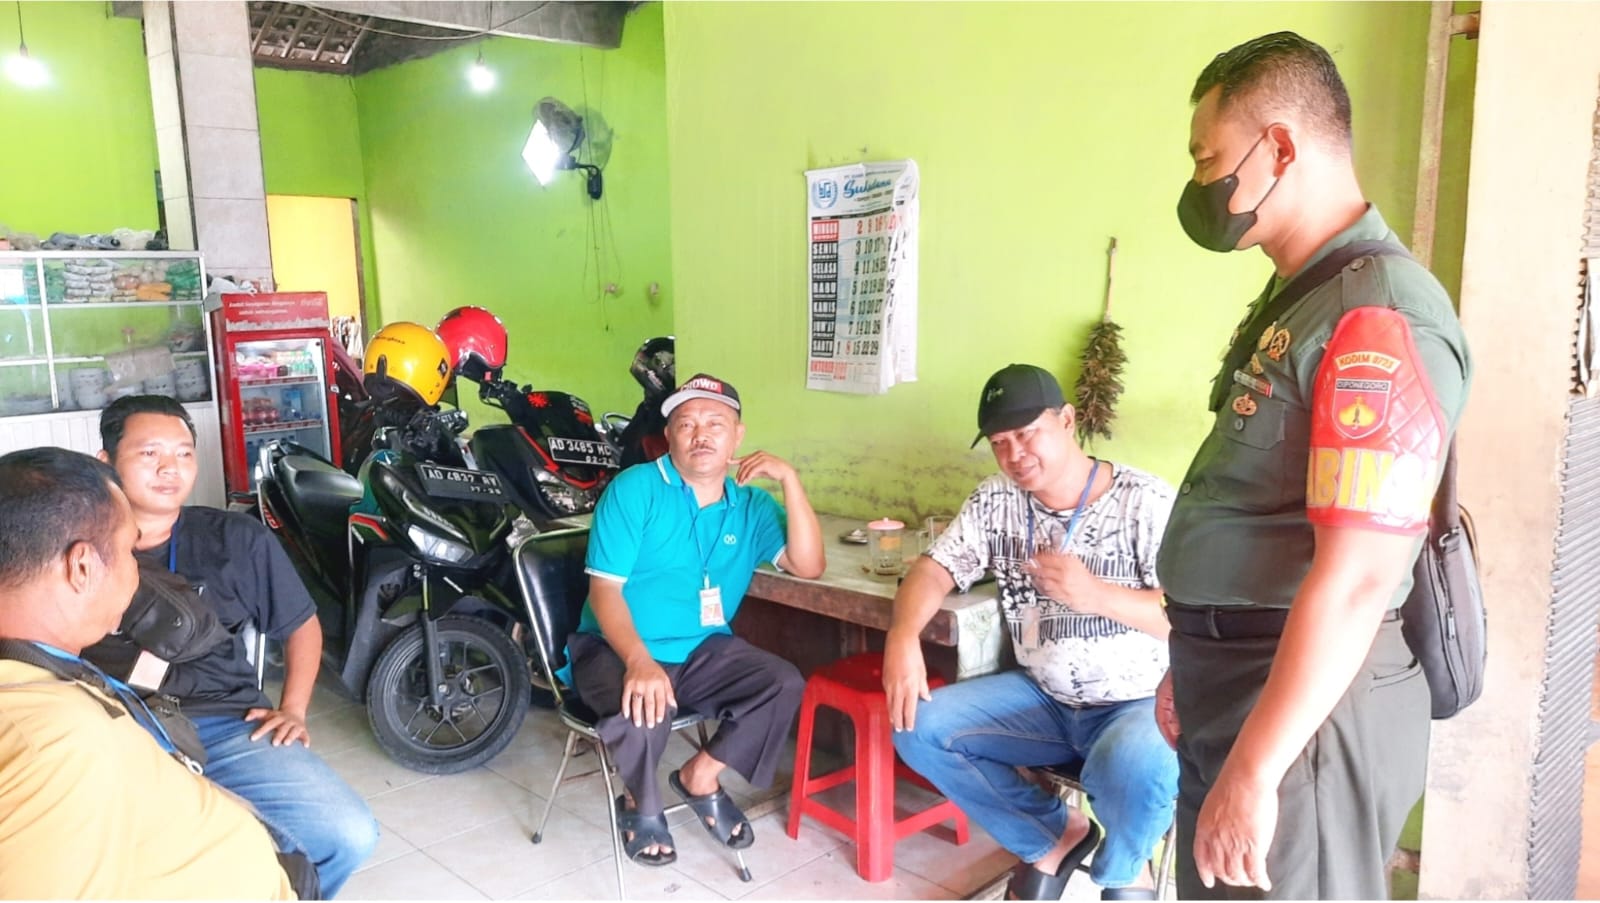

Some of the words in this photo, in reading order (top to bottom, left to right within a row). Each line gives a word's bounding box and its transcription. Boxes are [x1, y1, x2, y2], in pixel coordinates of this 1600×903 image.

[857, 220, 863, 235] 2
[813, 242, 837, 254] SENIN
[855, 240, 861, 255] 3
[813, 262, 836, 274] SELASA
[813, 282, 836, 293] RABU
[813, 302, 836, 313] KAMIS
[836, 341, 841, 355] 1
[1338, 353, 1371, 367] KODIM
[551, 438, 565, 450] AD
[428, 469, 443, 480] AD
